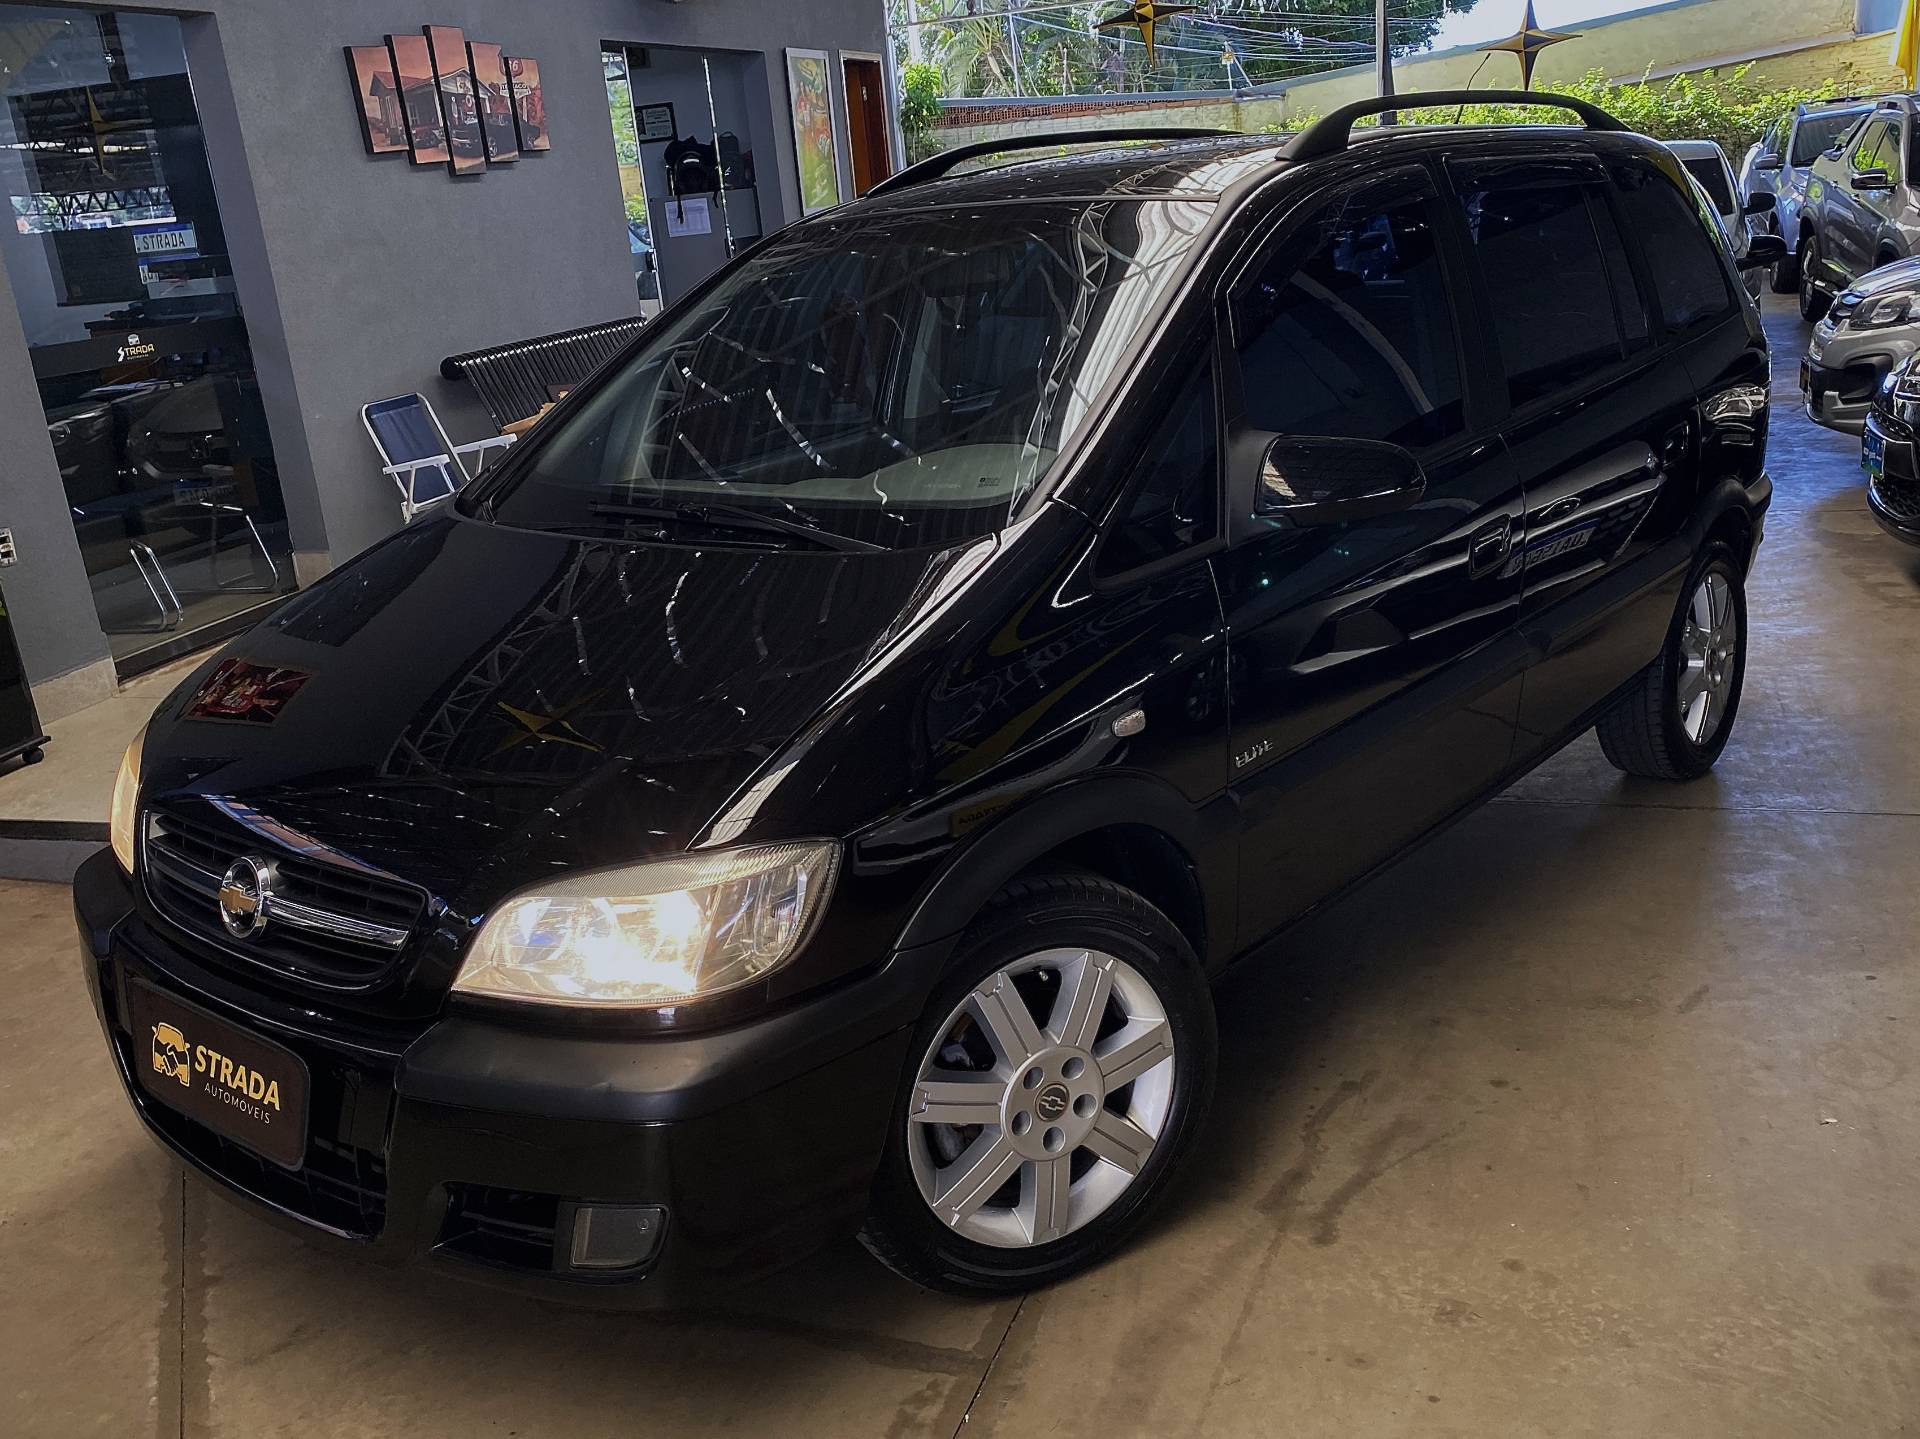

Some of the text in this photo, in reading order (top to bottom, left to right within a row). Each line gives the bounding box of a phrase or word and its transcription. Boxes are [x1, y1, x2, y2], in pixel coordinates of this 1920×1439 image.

[142, 232, 186, 250] STRADA
[117, 343, 155, 363] STRADA
[1235, 739, 1273, 768] ELITE
[194, 1044, 281, 1112] STRADA
